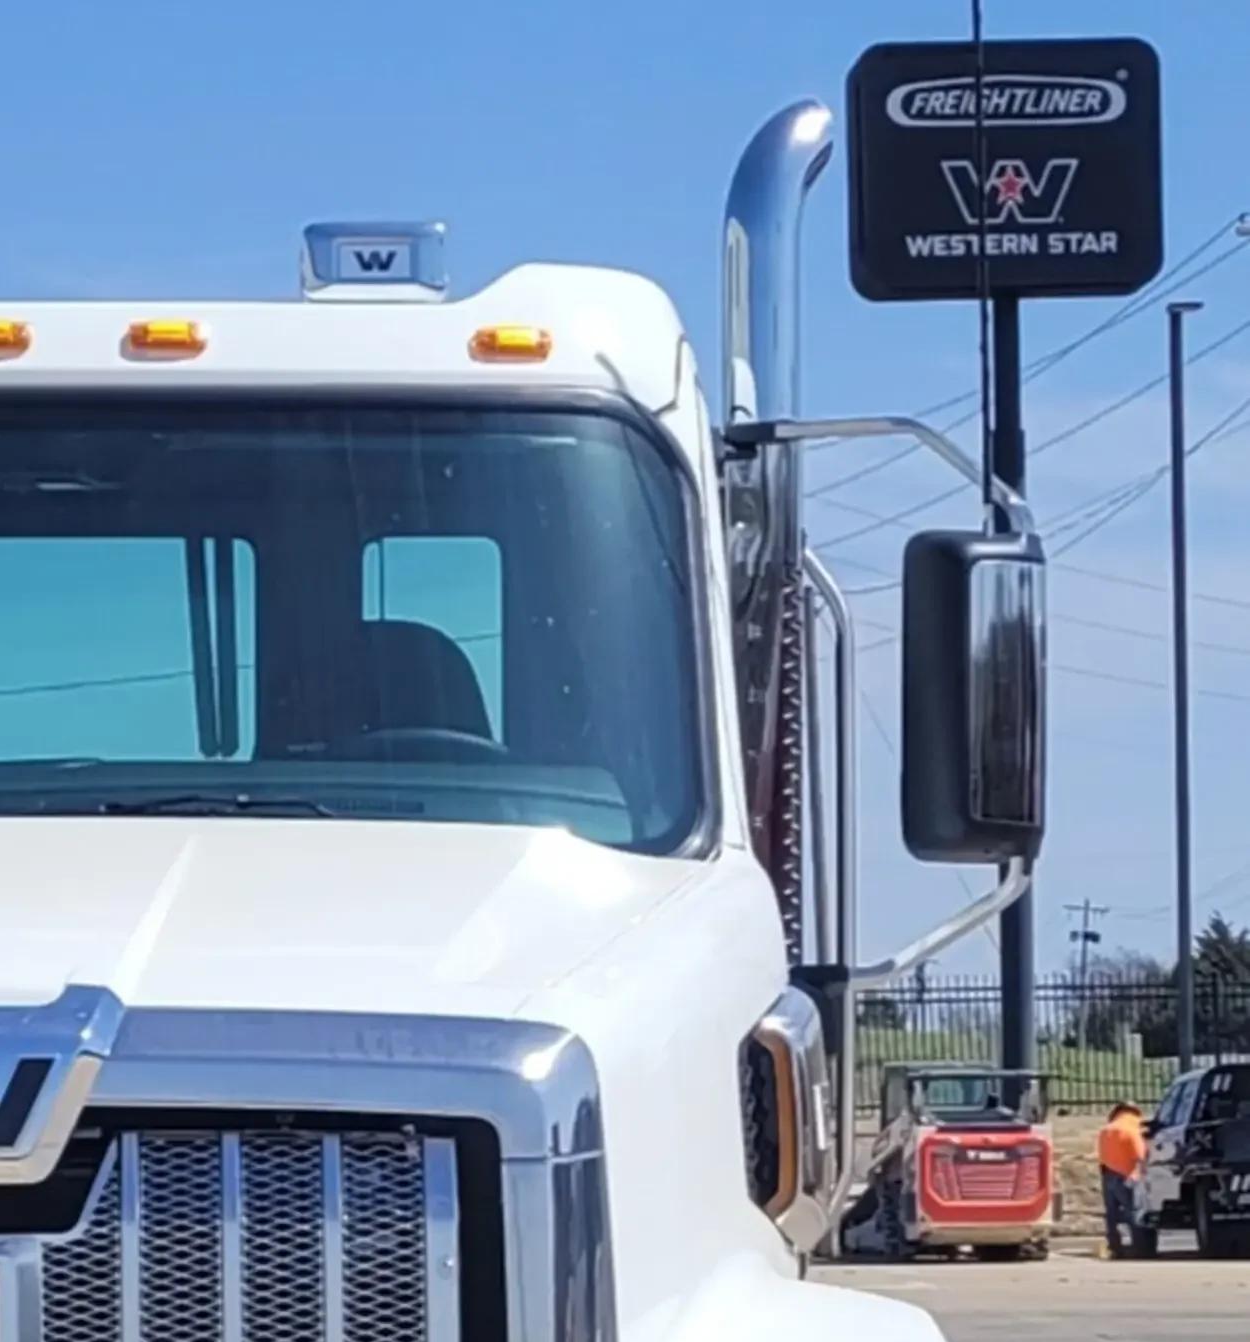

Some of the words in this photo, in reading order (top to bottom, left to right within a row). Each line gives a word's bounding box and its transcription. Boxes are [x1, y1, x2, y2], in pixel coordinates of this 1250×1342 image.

[910, 88, 1102, 115] FREIGHTLINER
[905, 233, 1038, 257] WESTERN
[1047, 231, 1118, 254] STAR
